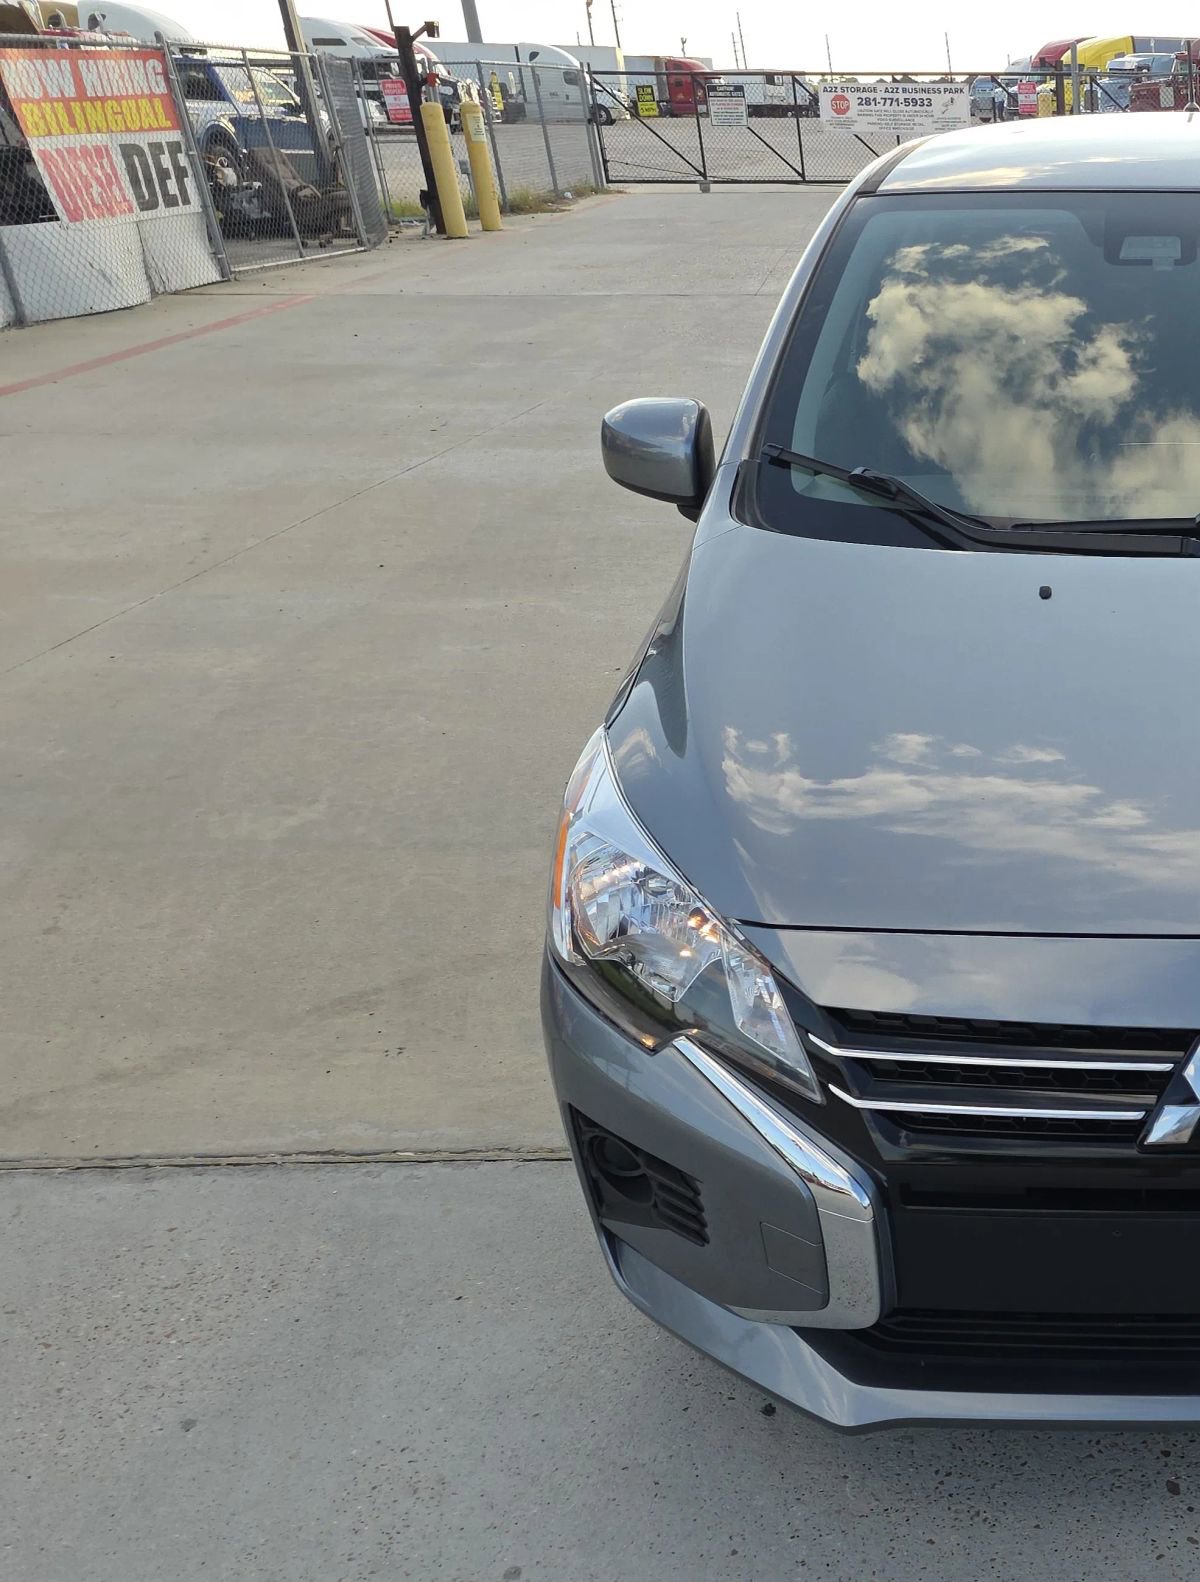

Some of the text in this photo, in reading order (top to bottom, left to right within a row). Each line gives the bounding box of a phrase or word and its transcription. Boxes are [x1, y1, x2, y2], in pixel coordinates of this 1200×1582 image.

[0, 58, 168, 98] NOW HIRING
[857, 96, 933, 107] 281-771-5933
[901, 87, 941, 95] BUSINESS
[21, 97, 172, 136] BILINGUAL
[831, 100, 849, 110] STOP
[119, 140, 192, 212] DEF
